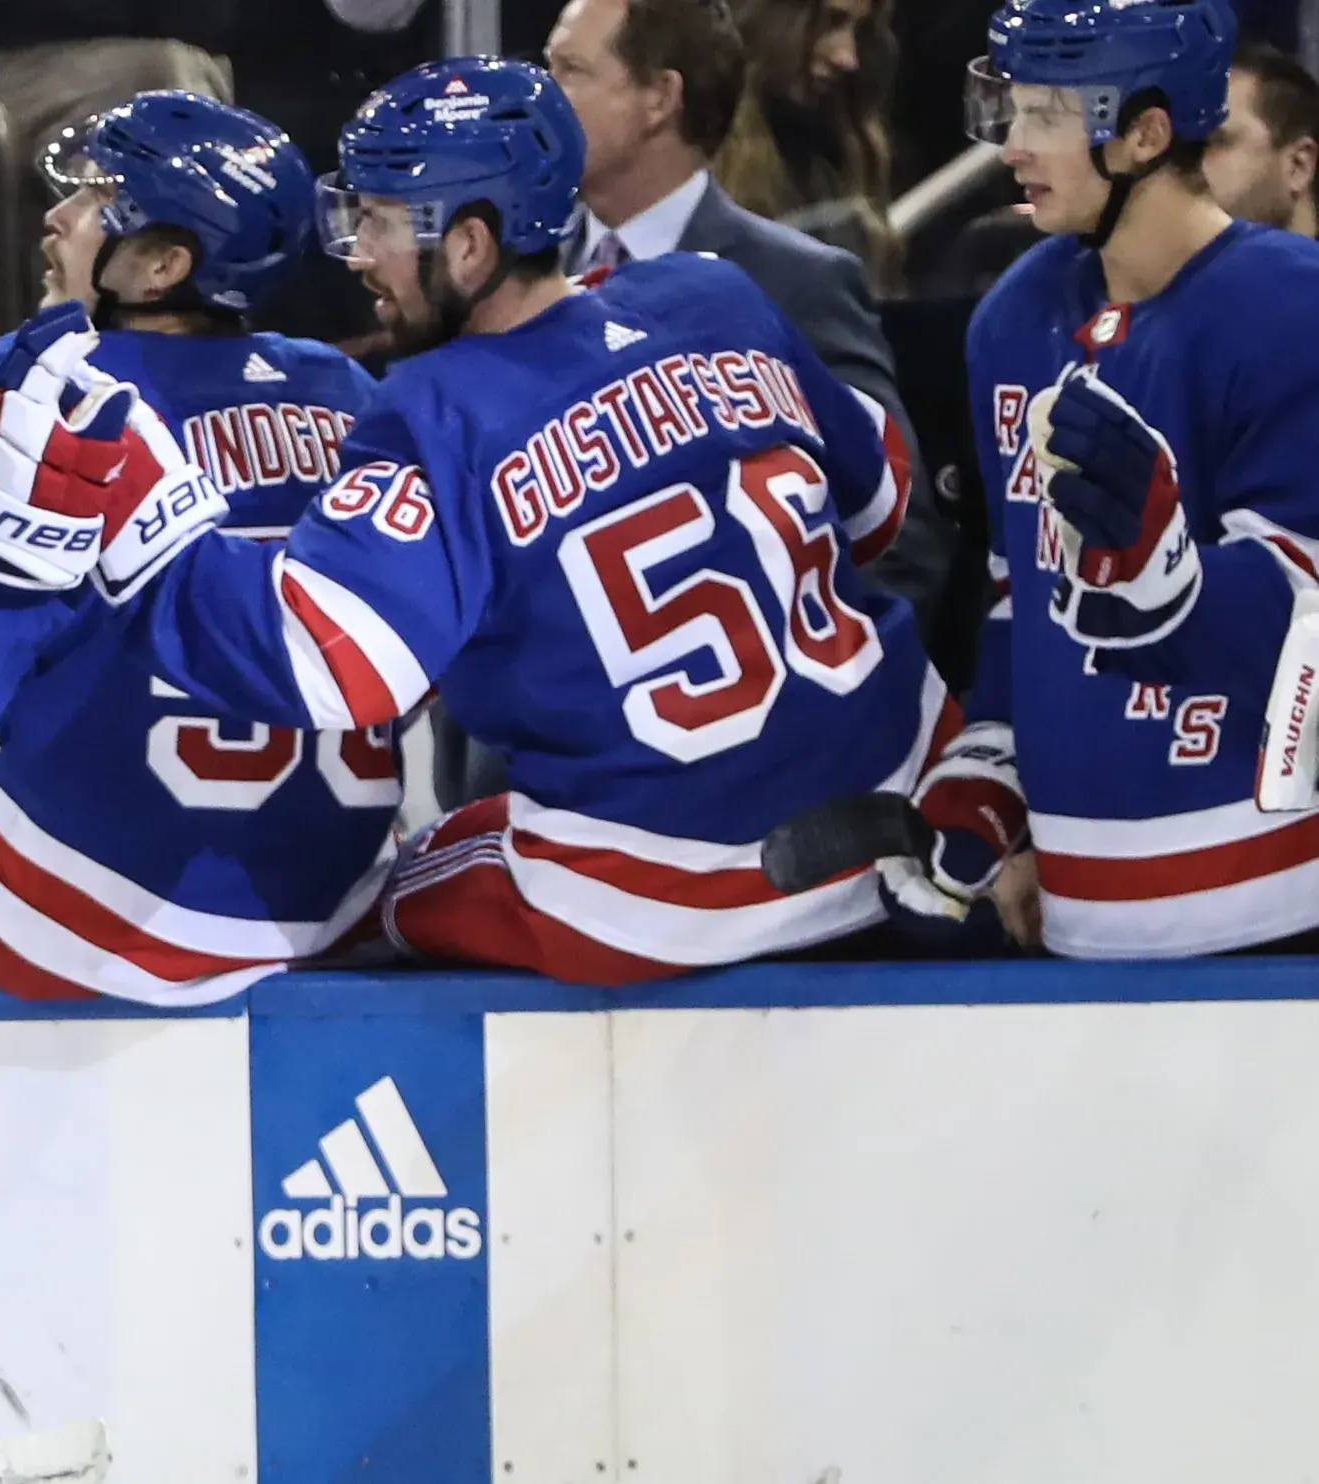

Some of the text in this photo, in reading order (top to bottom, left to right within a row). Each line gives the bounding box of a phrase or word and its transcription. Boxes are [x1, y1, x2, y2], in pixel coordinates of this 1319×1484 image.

[321, 460, 436, 543] 56
[557, 445, 884, 764] 56
[1280, 664, 1316, 777] VAUGHN
[259, 1193, 482, 1260] adidas
